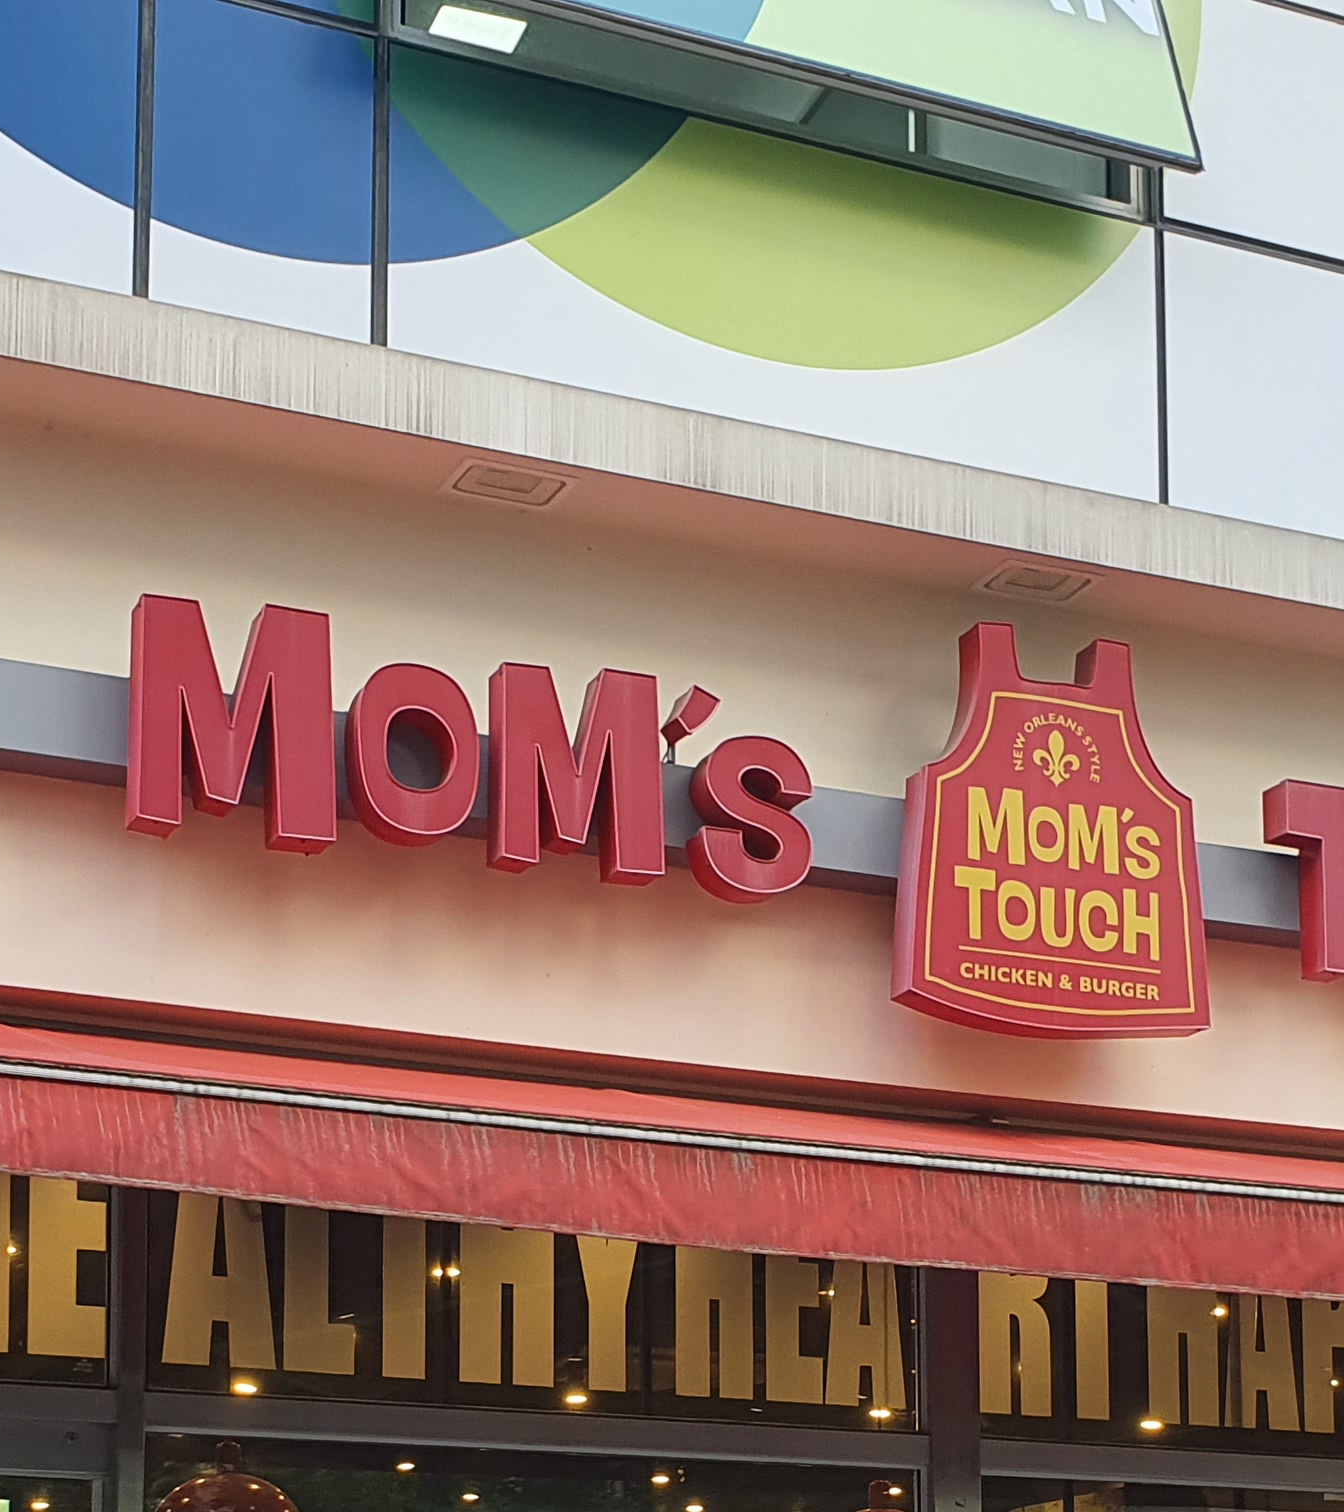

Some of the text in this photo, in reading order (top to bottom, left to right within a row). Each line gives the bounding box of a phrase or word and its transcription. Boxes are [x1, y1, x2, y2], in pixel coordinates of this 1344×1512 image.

[1013, 713, 1102, 784] NEW ORLEANS STYLE
[954, 865, 1161, 961] TOUCH
[959, 961, 1161, 1002] CHICKEN & BURGER
